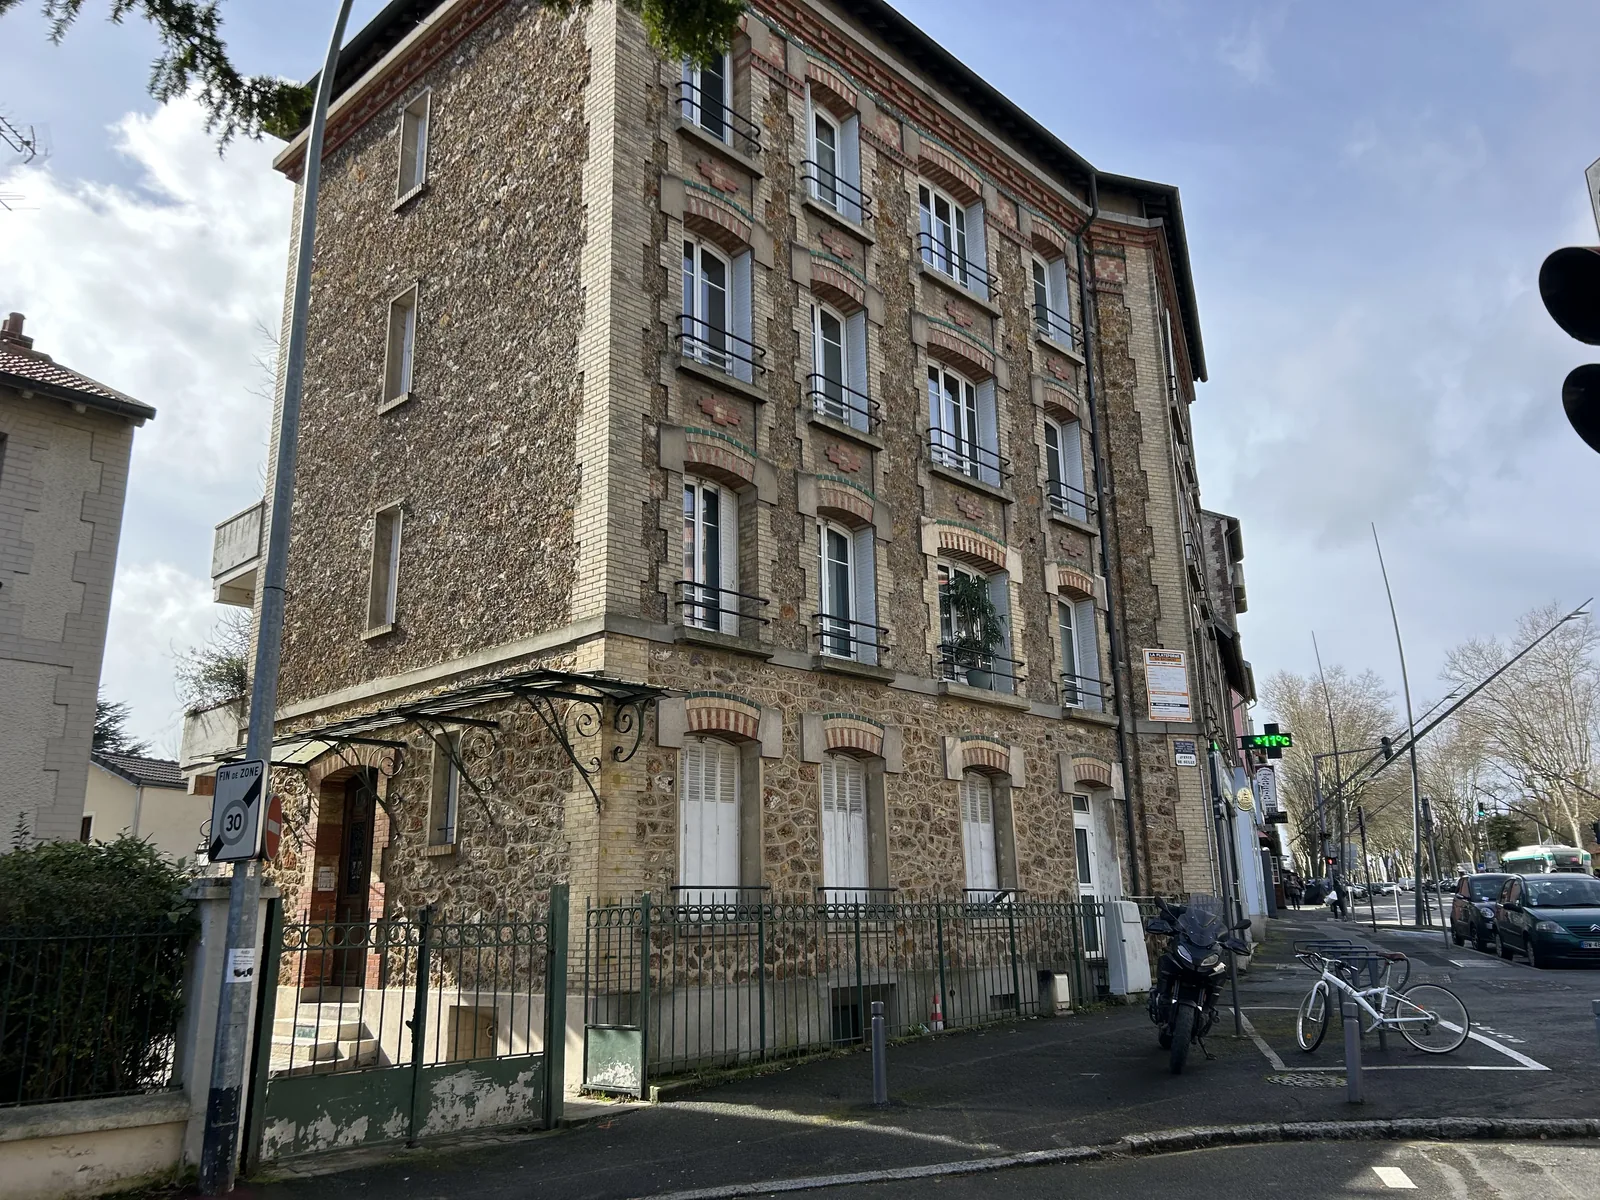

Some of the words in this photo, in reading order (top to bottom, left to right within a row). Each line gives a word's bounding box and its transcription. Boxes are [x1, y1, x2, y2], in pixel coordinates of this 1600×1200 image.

[219, 771, 231, 781] FIN
[240, 766, 260, 778] ZONE
[225, 813, 242, 832] 30
